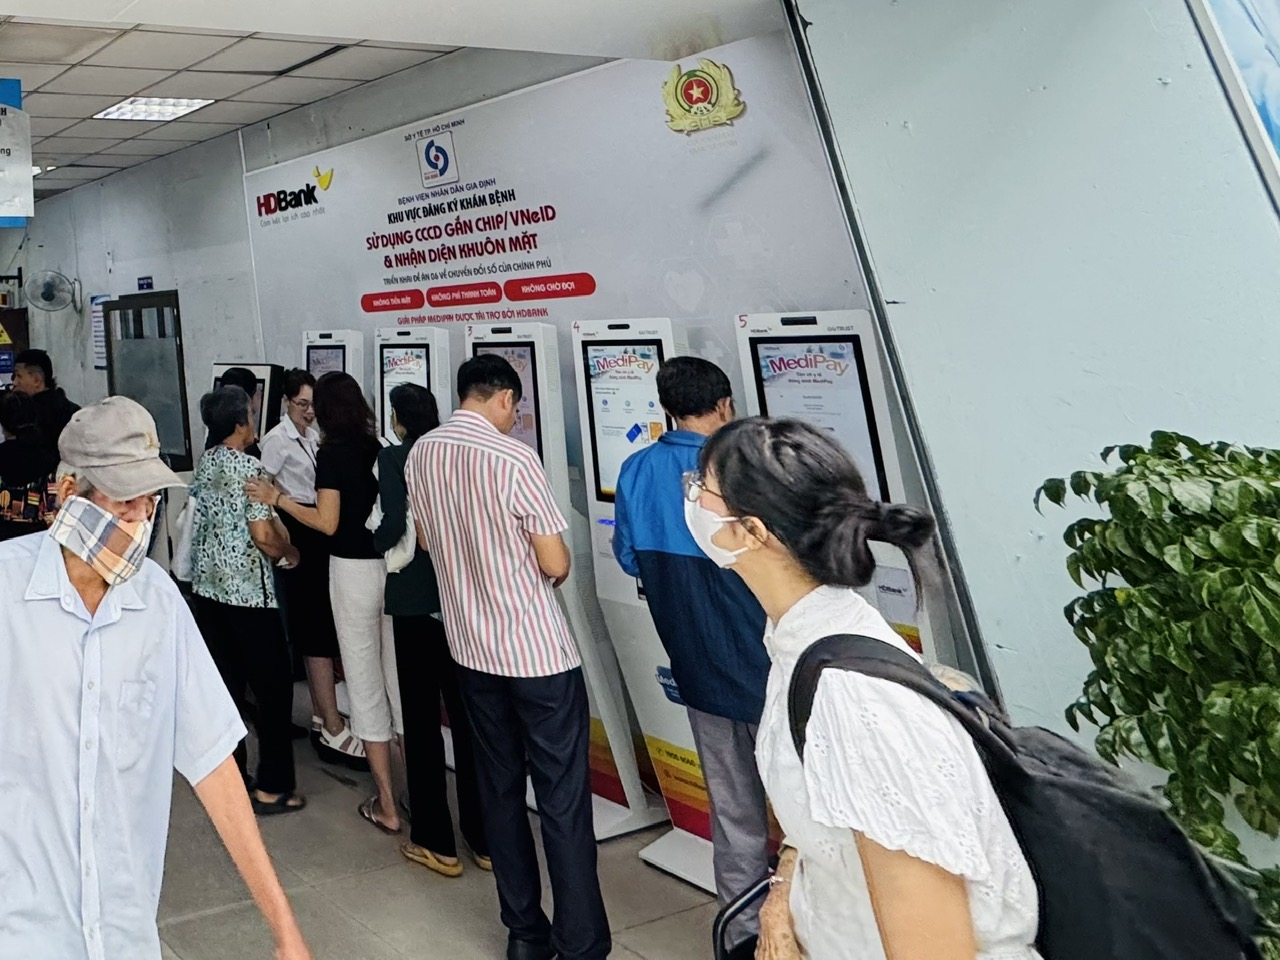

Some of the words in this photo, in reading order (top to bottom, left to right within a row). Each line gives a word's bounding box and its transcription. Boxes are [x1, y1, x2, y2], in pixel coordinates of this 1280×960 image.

[432, 125, 440, 133] HỒ
[441, 123, 450, 131] CHÍ
[451, 119, 465, 128] MINH
[256, 183, 319, 217] HDBank
[398, 195, 415, 206] BỆNH
[415, 190, 430, 201] VIỆN
[430, 187, 449, 198] NHÂN
[449, 184, 464, 194] DÂN
[465, 182, 478, 191] GIA
[478, 178, 496, 189] ĐỊNH
[387, 210, 404, 224] KHU
[405, 207, 422, 223] VỰC
[422, 202, 446, 218] ĐĂNG
[447, 198, 458, 213] KÝ
[459, 193, 488, 210] KHÁM
[488, 188, 516, 207] BỆNH
[366, 231, 380, 250] SỬ
[380, 230, 413, 249] DỤNG
[415, 225, 442, 242] CCCD
[444, 215, 473, 237] GẮN
[509, 205, 556, 226] VNeID
[384, 255, 393, 268] &
[394, 248, 426, 268] NHẬN
[428, 244, 457, 264] DIỆN
[458, 236, 506, 259] KHUÔN
[508, 230, 538, 254] MẶT
[431, 272, 439, 280] 06
[487, 262, 497, 274] SỐ
[498, 261, 513, 273] CỦA
[513, 260, 535, 271] CHÍNH
[535, 257, 552, 268] PHỦ
[521, 283, 546, 293] KHÔNG
[547, 281, 561, 291] CHỜ
[486, 310, 501, 321] TRỢ
[517, 308, 549, 317] HDBANK
[738, 314, 748, 328] 5
[573, 321, 580, 333] 4
[595, 355, 655, 373] MediPay
[769, 353, 850, 376] MediPay
